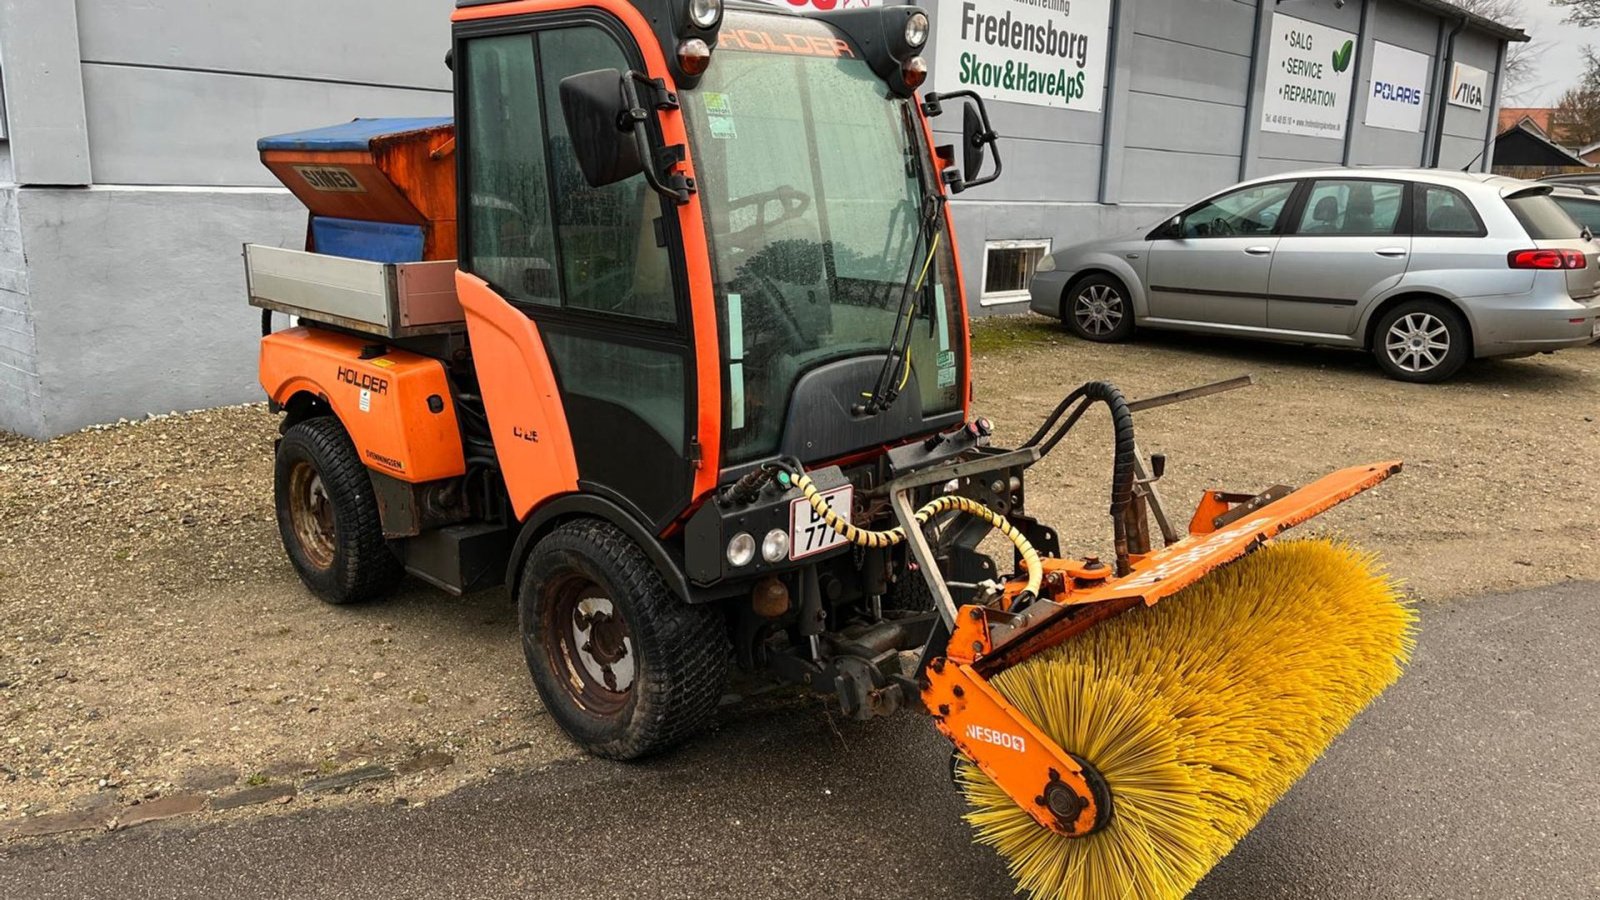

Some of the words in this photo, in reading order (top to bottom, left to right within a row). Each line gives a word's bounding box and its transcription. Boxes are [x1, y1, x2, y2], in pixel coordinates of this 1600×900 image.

[718, 29, 855, 58] HOLDER
[961, 1, 1088, 68] Fredensborg
[1290, 30, 1313, 51] SALG
[1287, 57, 1323, 79] SERVICE
[1283, 84, 1336, 107] REPARATION
[1373, 81, 1421, 105] POLARIS
[337, 366, 389, 395] HOLDER
